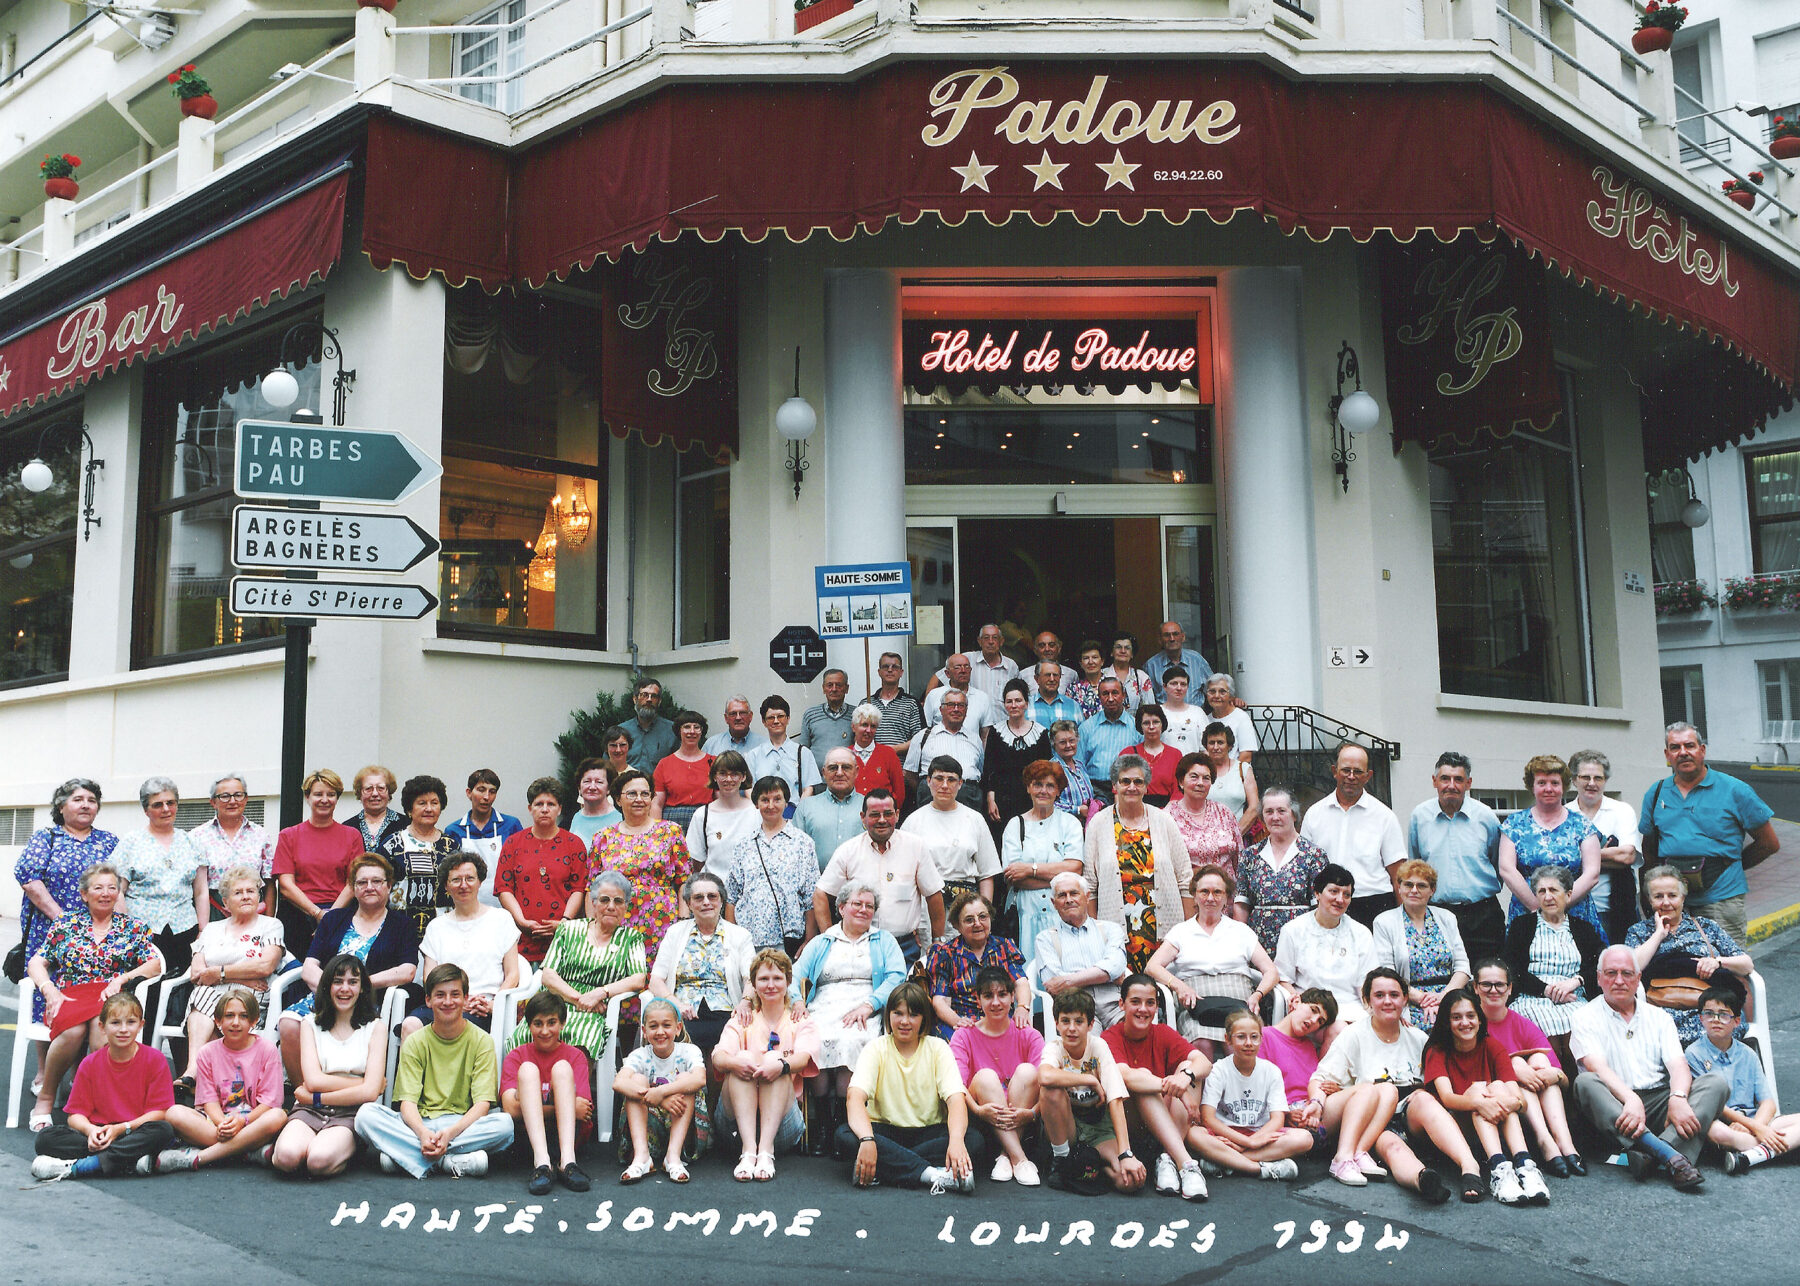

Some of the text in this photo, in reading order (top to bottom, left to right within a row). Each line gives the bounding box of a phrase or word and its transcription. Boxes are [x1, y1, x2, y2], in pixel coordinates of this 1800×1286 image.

[921, 66, 1241, 147] Padoue
[1153, 170, 1223, 181] 62.94.22.60
[1586, 166, 1739, 297] Hôtel
[47, 284, 184, 379] Bar
[1023, 330, 1060, 372] de
[1071, 328, 1195, 372] Padoue
[251, 434, 363, 462] TARBES
[249, 462, 305, 487] PAU
[247, 516, 362, 540] ARGELÈS
[246, 539, 380, 563] BAGNÈRES
[826, 571, 901, 585] HAUTE-SOMME
[244, 587, 292, 607] Cité
[335, 591, 404, 611] Pierre
[822, 625, 848, 634] ATHIES
[858, 624, 875, 632] HAM
[885, 622, 909, 631] NESLE
[789, 645, 807, 667] H
